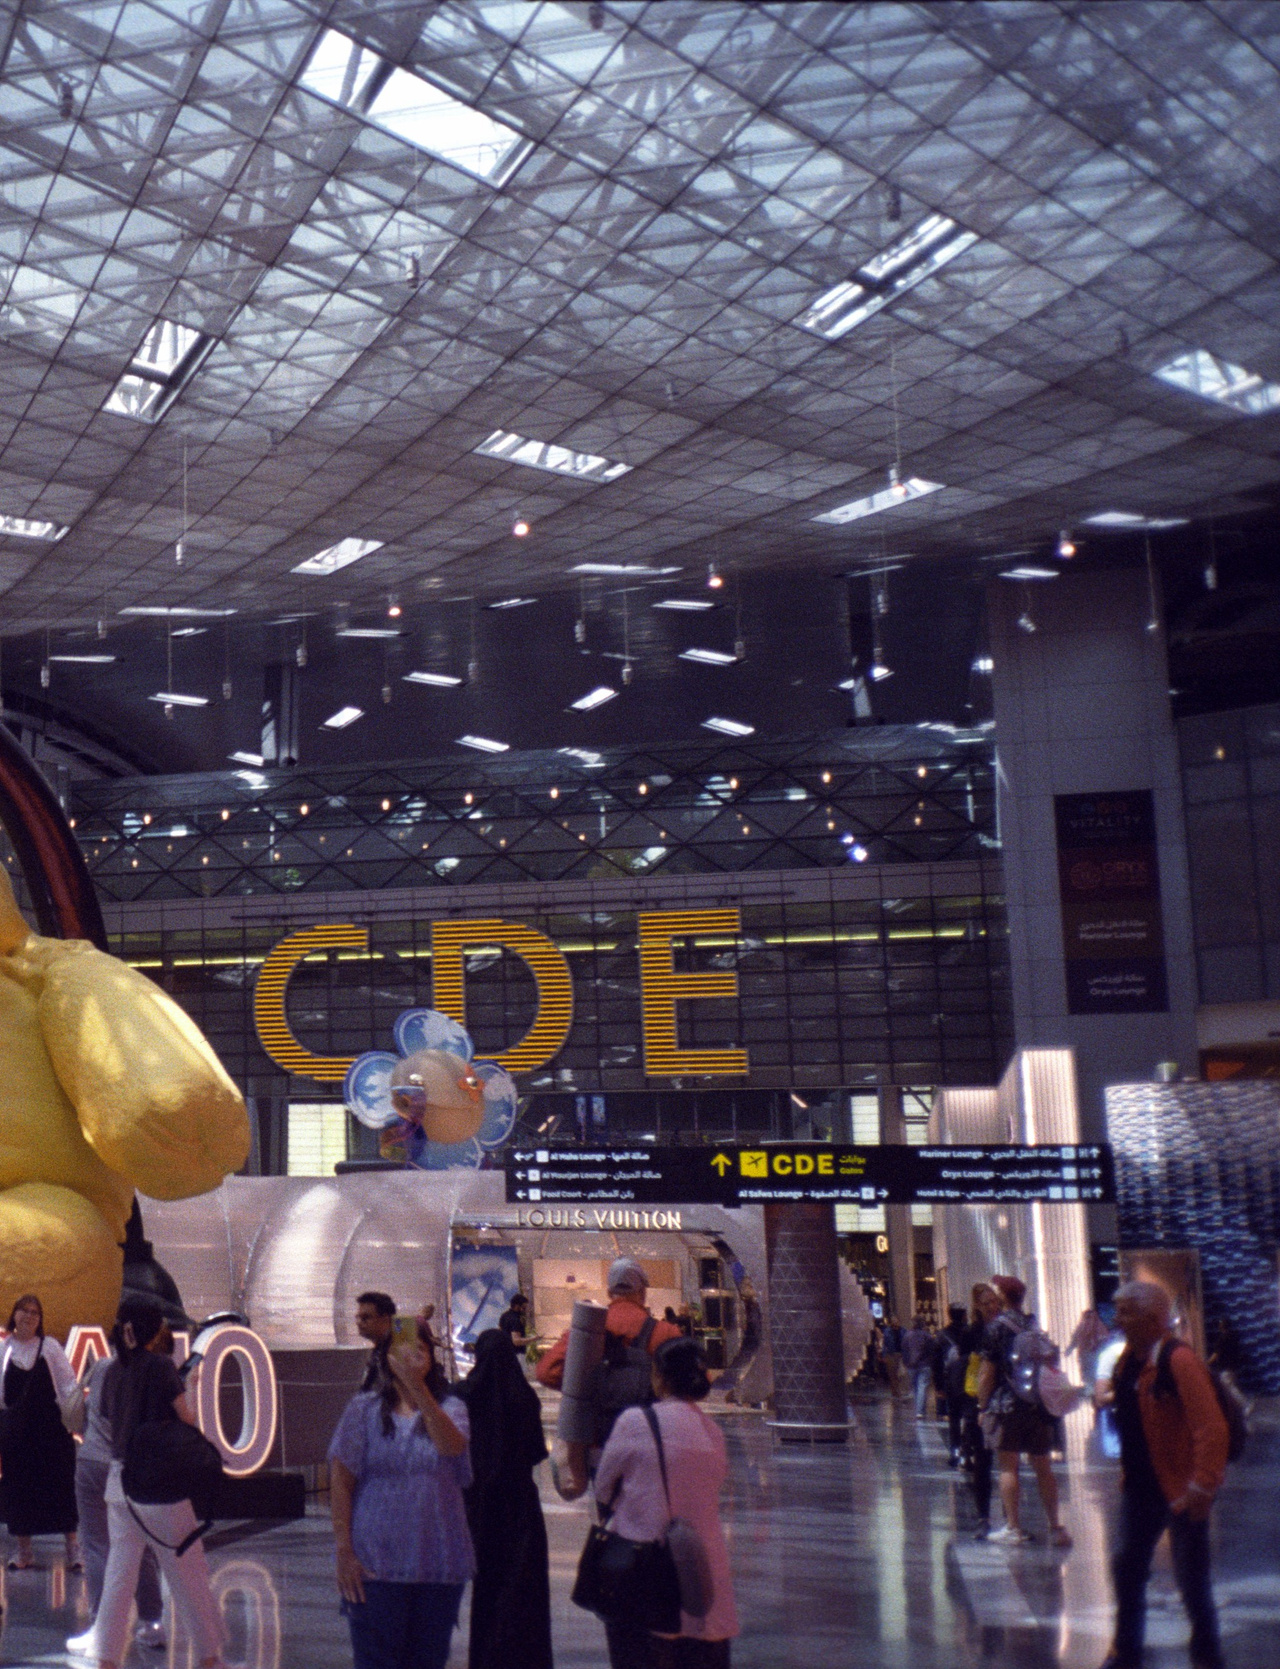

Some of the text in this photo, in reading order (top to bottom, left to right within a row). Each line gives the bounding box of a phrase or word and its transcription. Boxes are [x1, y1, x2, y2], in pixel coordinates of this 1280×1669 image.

[579, 1153, 606, 1162] Lounge
[920, 1150, 984, 1160] Mariner Lounge
[772, 1154, 834, 1175] CDE
[580, 1172, 607, 1181] Lounge
[942, 1170, 995, 1180] Oryx Lounge
[774, 1190, 803, 1199] Lounge
[516, 1209, 682, 1230] LOUIS VUITTON
